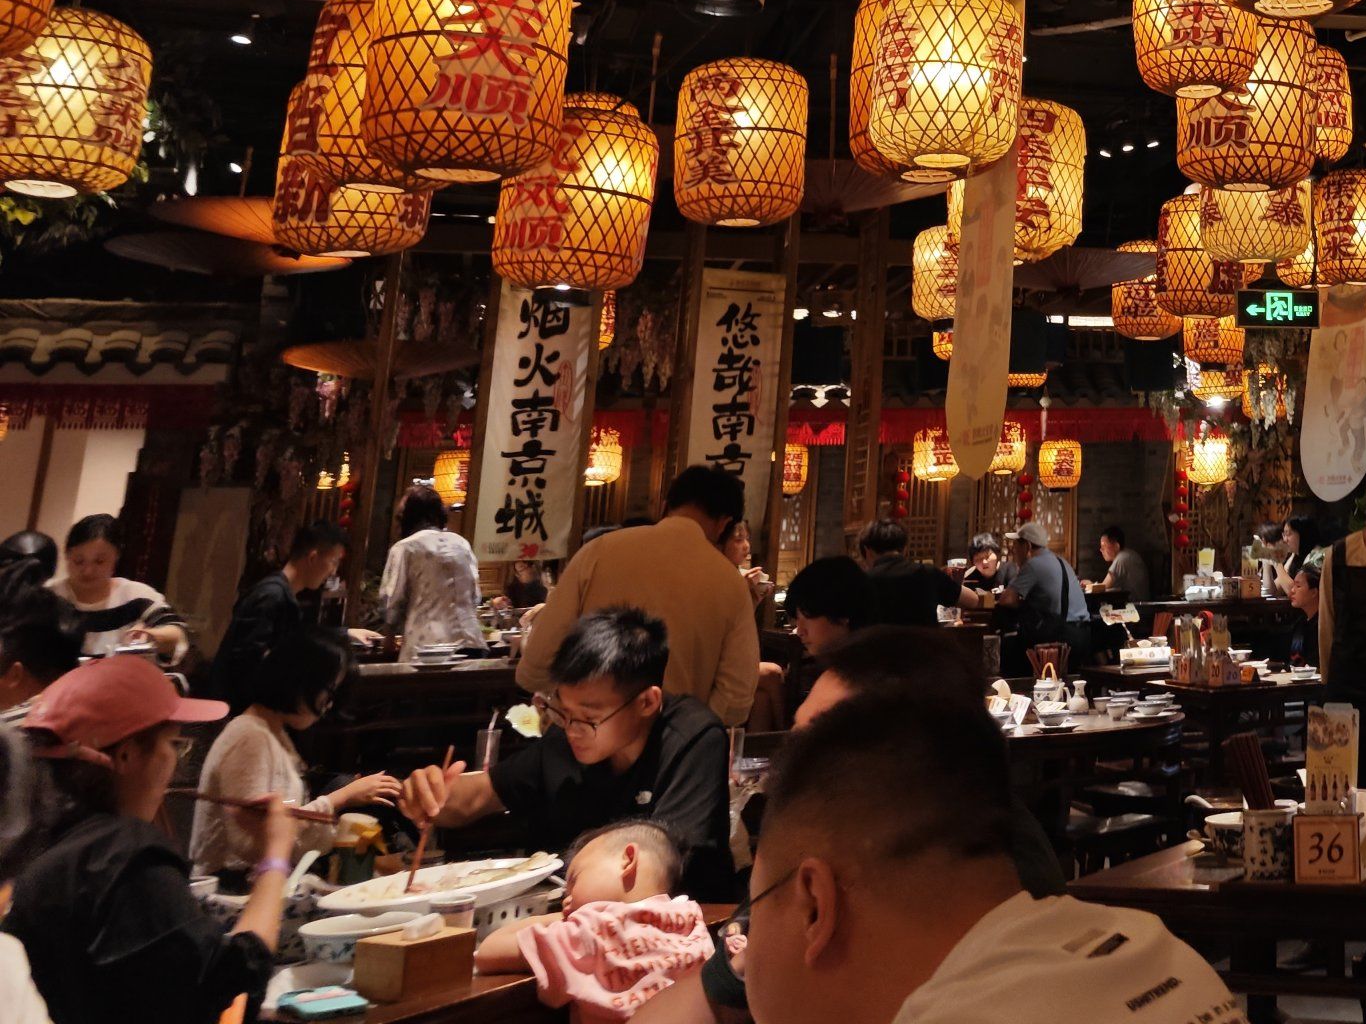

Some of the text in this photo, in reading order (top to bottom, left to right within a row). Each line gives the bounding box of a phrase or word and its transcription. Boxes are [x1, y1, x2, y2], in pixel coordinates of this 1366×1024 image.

[494, 296, 571, 541] 烟火南京城
[1308, 831, 1344, 864] 36
